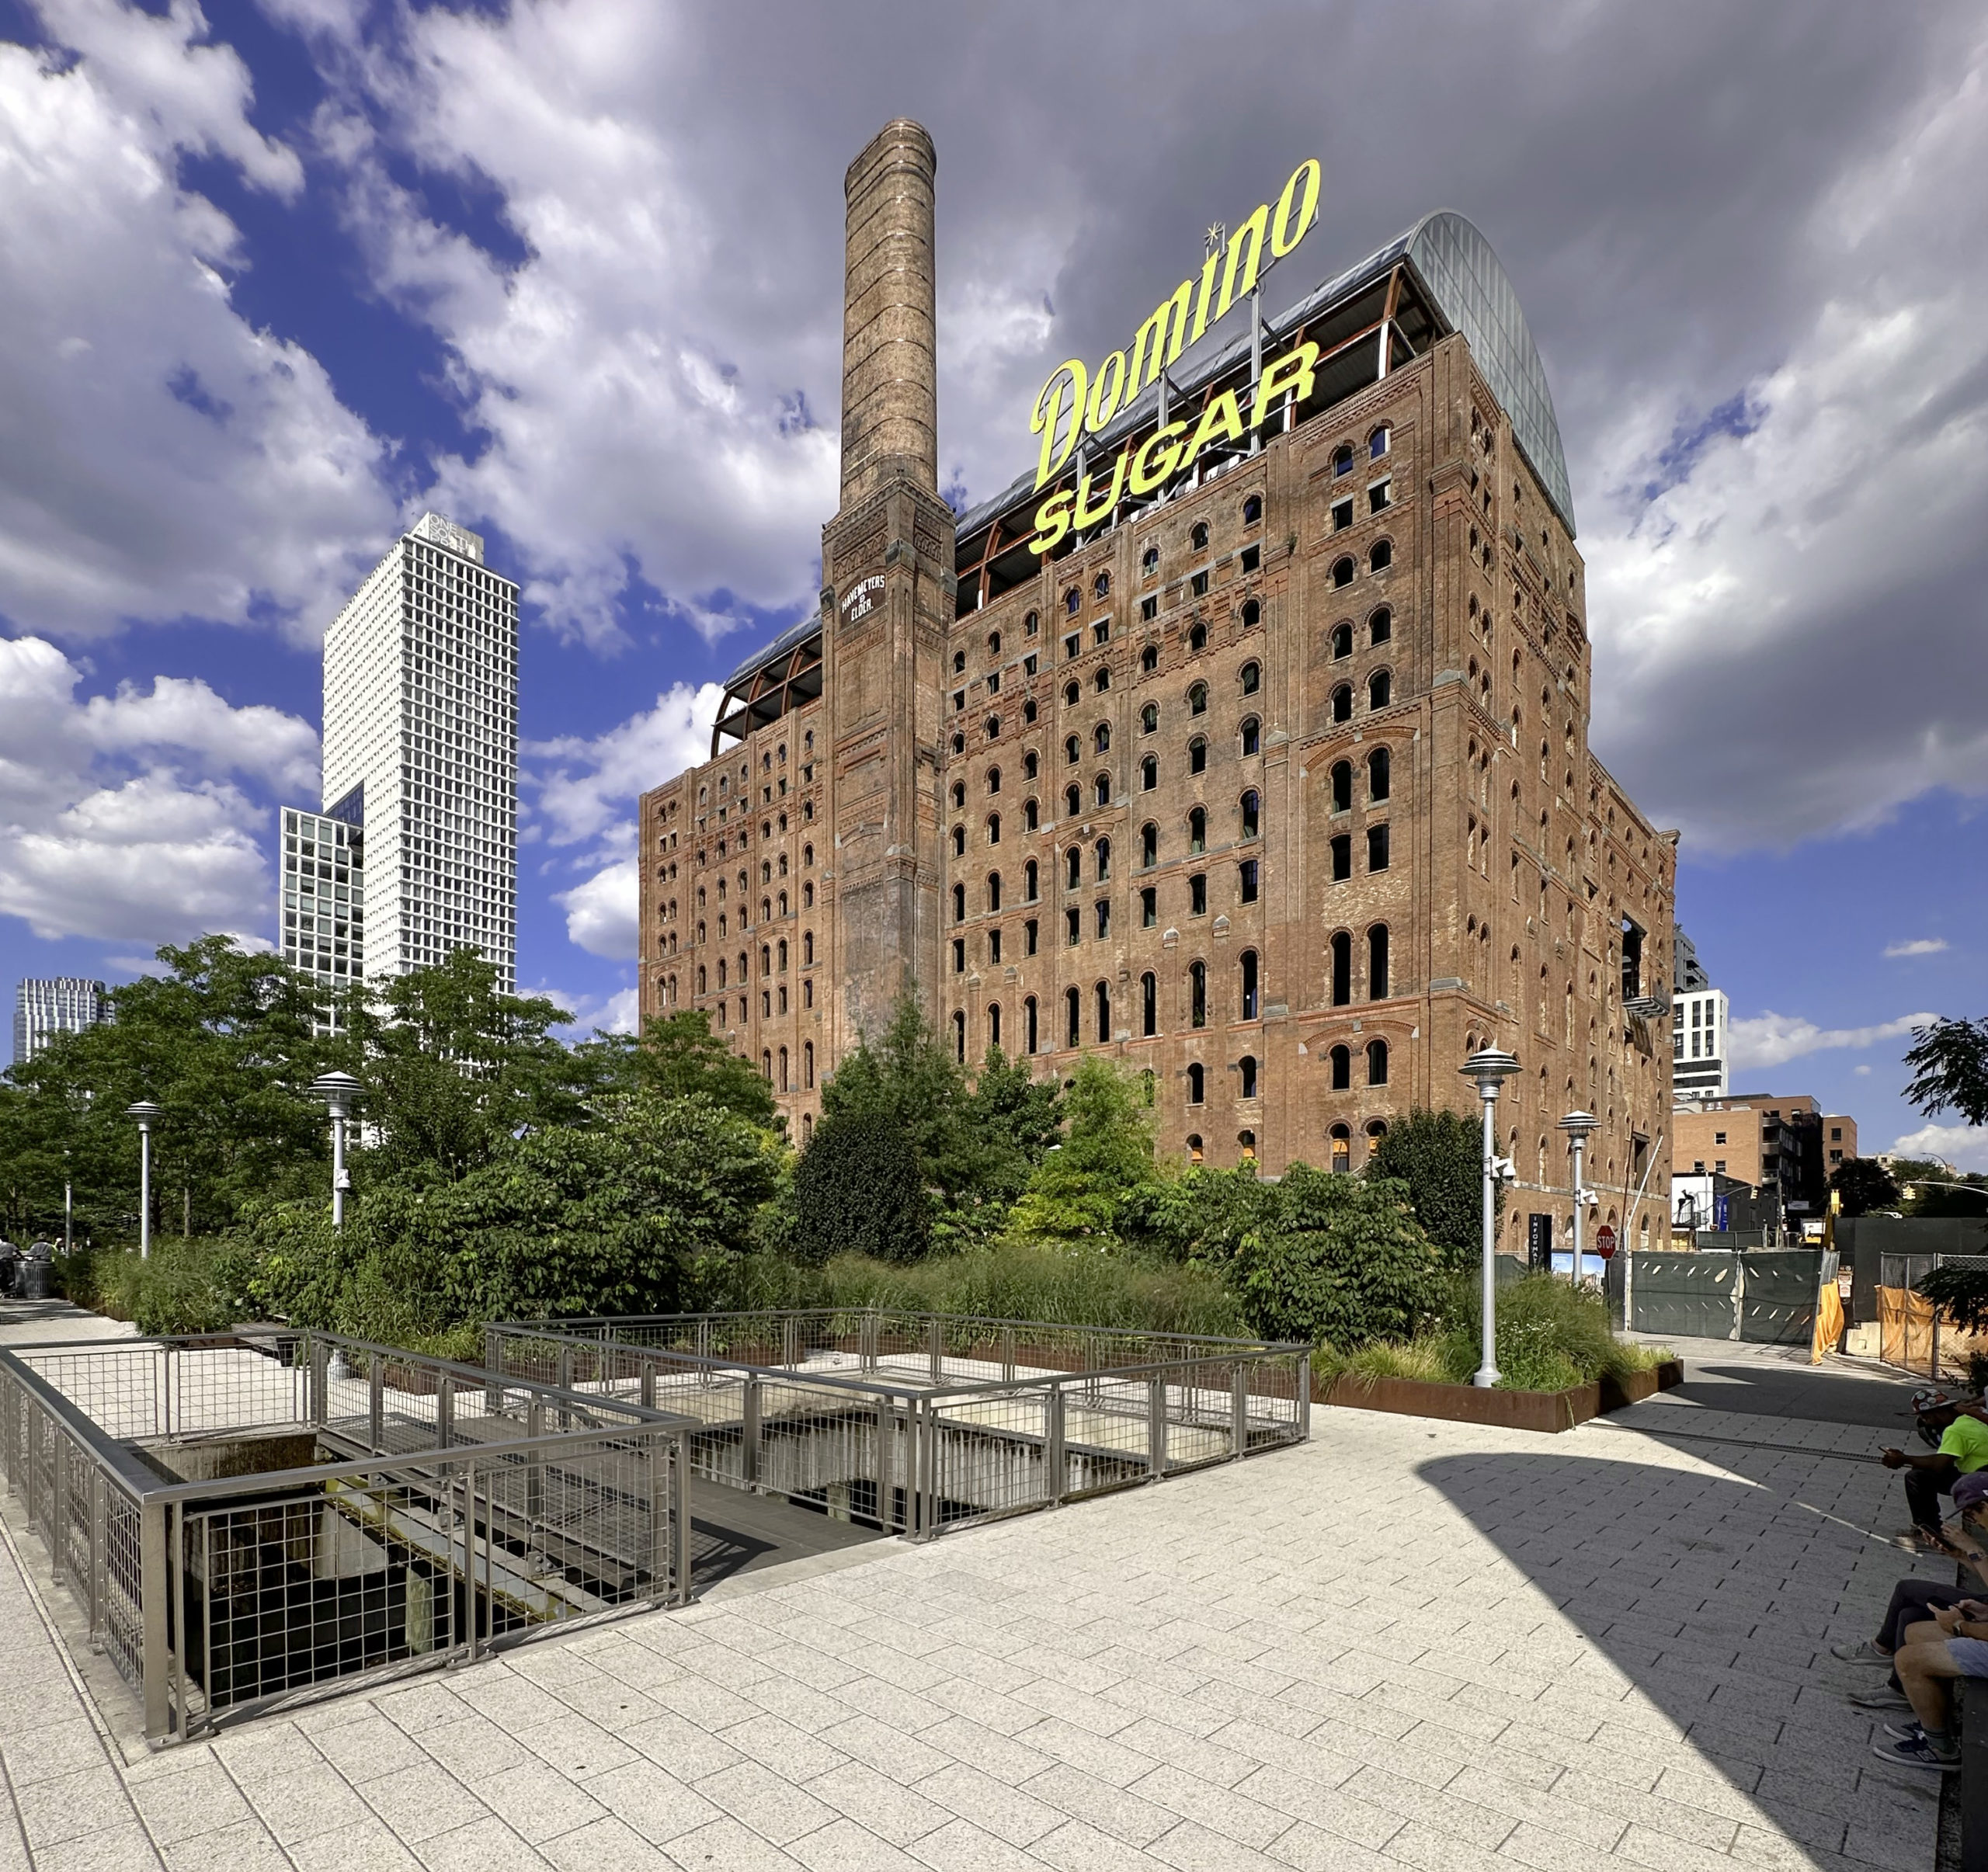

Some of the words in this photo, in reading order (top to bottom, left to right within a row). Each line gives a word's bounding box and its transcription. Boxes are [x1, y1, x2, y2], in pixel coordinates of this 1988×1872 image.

[1030, 158, 1320, 494] Domino
[1028, 341, 1320, 554] SUGAR
[430, 514, 457, 534] ONE
[842, 575, 885, 613] HAVEMEYERS
[1597, 1235, 1615, 1249] STOP
